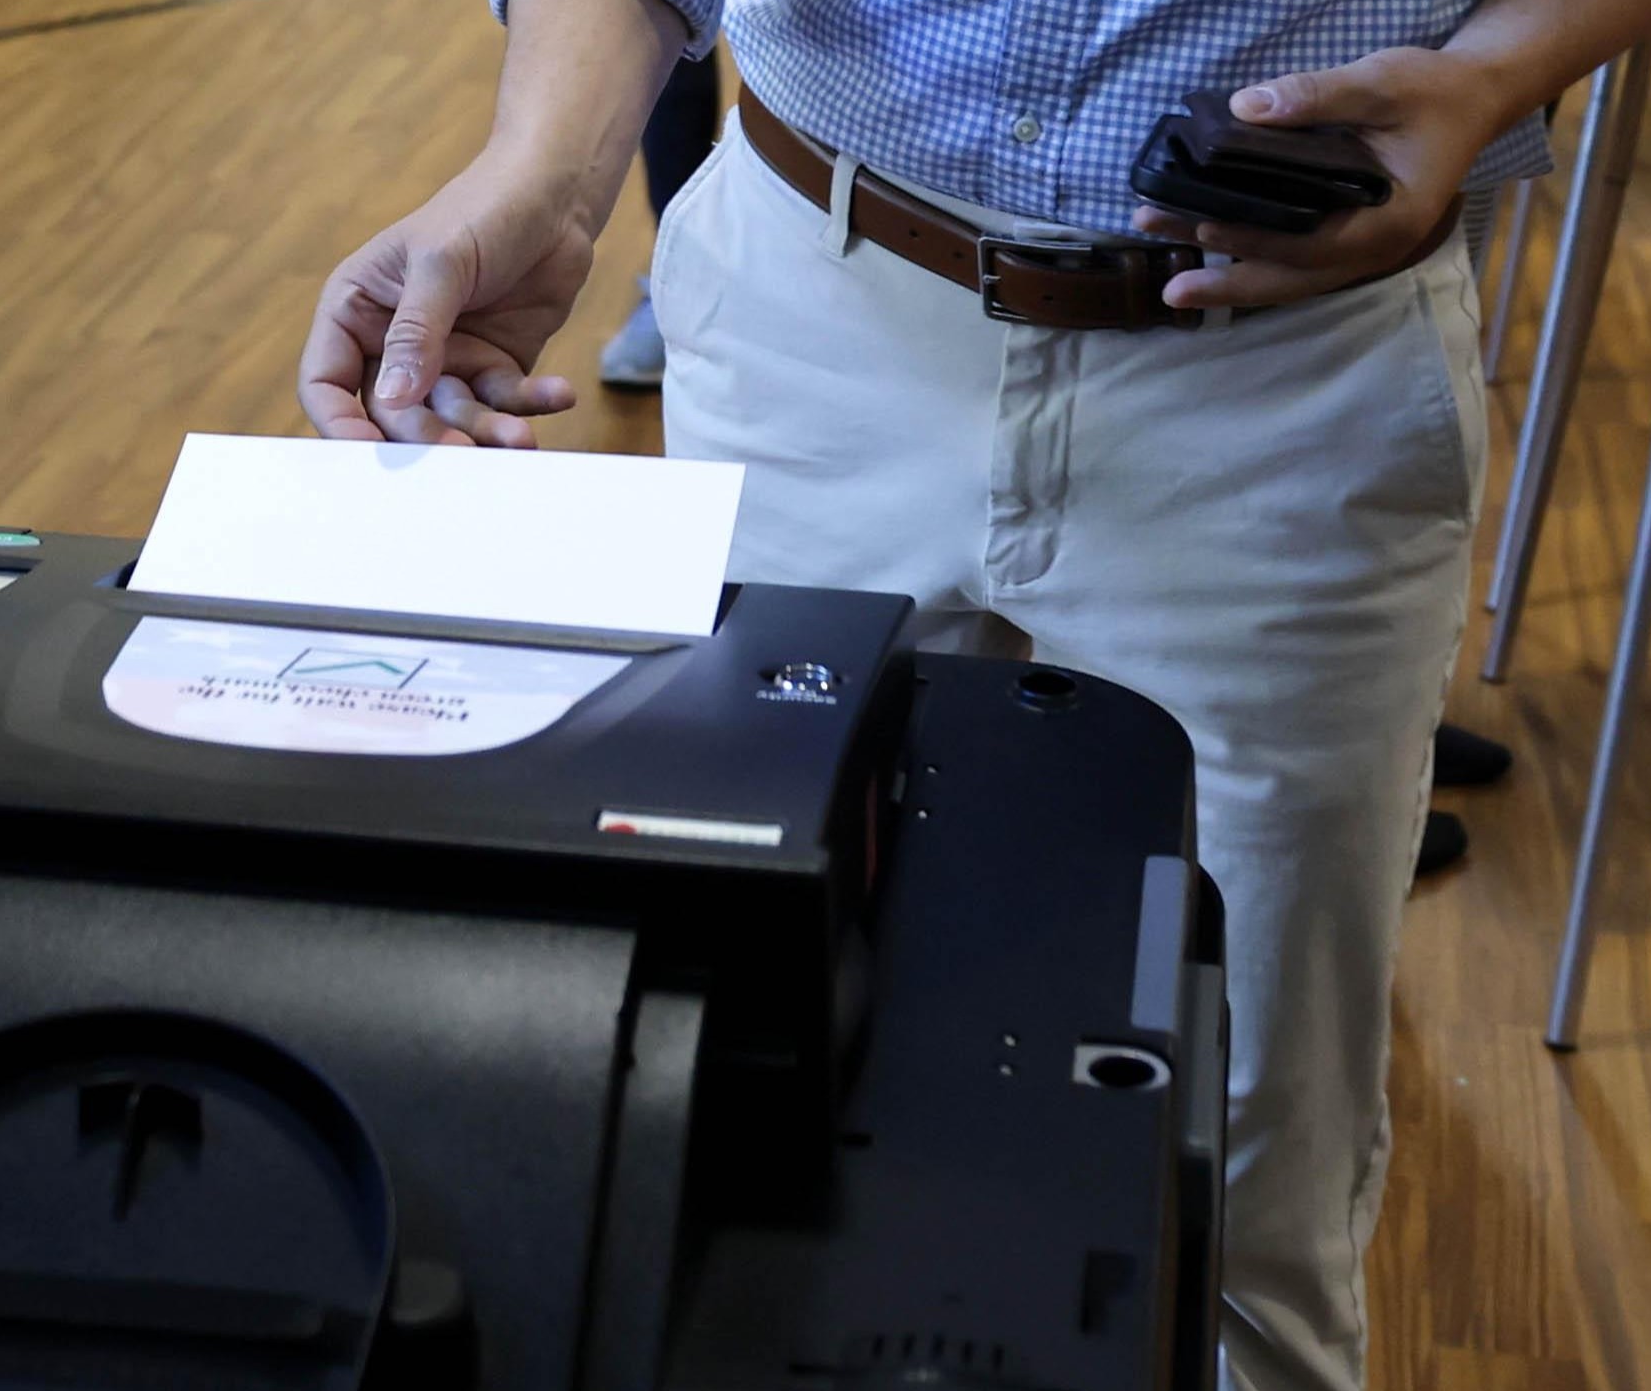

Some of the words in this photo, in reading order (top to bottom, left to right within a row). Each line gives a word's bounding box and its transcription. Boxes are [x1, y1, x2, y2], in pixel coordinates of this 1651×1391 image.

[179, 686, 225, 699] the
[238, 690, 280, 703] for
[380, 691, 466, 707] green
[292, 695, 356, 711] wait
[368, 702, 470, 723] Please
